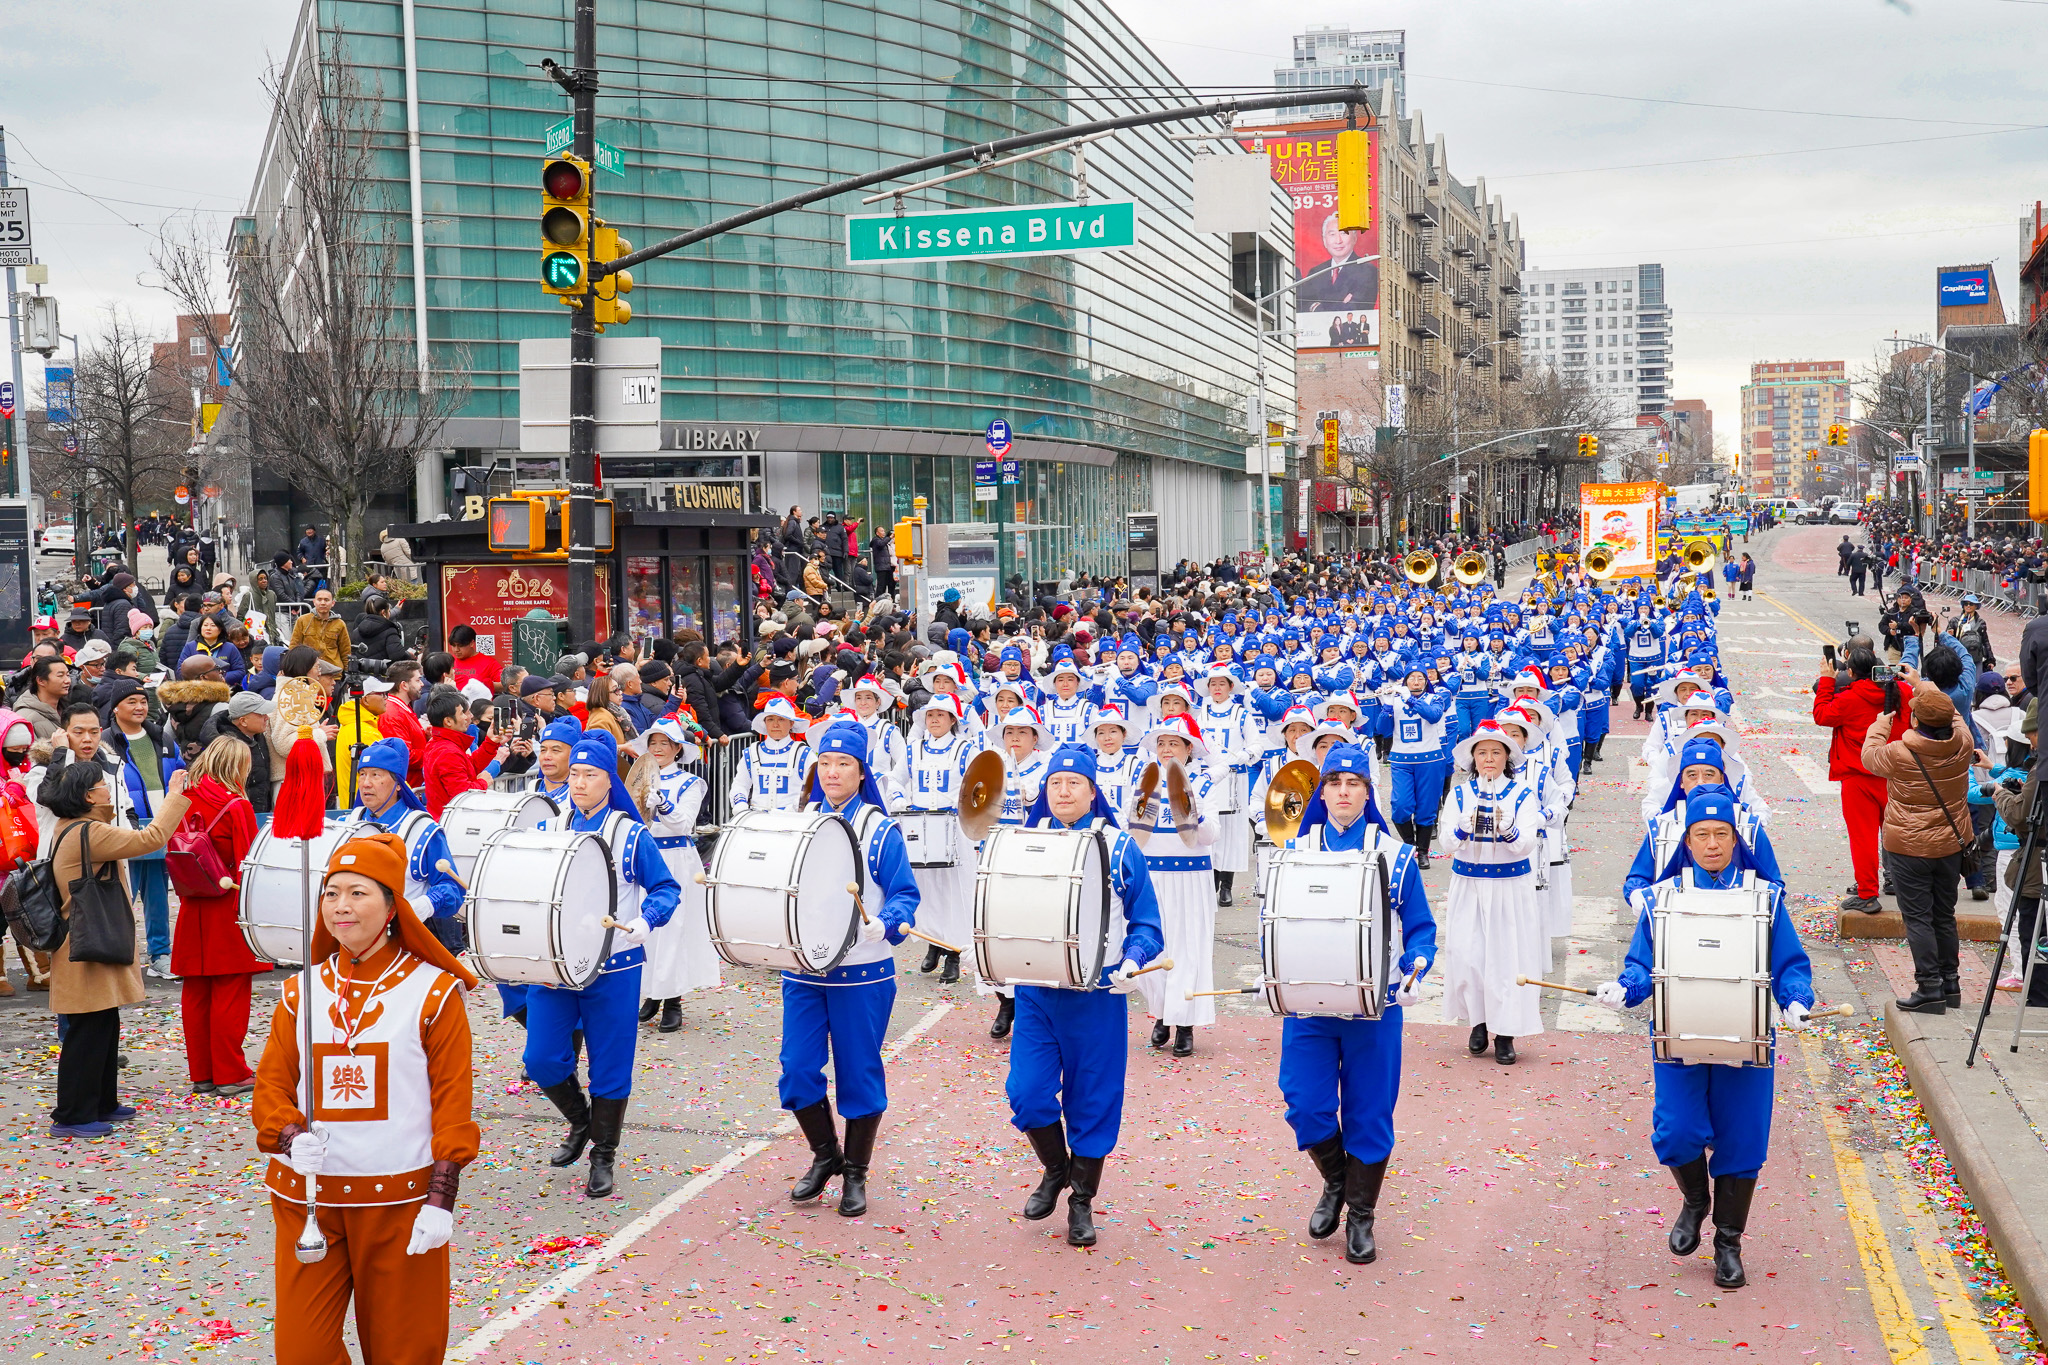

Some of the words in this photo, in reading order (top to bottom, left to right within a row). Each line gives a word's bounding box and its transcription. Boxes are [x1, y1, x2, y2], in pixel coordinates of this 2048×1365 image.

[546, 126, 570, 152] Kissena
[594, 141, 612, 168] Main
[1271, 157, 1338, 182] 外伤害
[0, 191, 12, 199] TY
[1294, 194, 1338, 210] 39-3
[878, 225, 1016, 250] Kissena
[1028, 214, 1105, 243] Blvd
[673, 428, 761, 450] LIBRARY
[1003, 462, 1016, 472] Q20
[1003, 475, 1015, 484] Q44
[673, 484, 742, 509] FLUSHING
[1591, 487, 1647, 497] 法輪大法好
[496, 577, 553, 598] 2026
[470, 615, 496, 625] 2026
[1405, 726, 1417, 737] 樂
[1003, 798, 1016, 815] 樂
[330, 1064, 368, 1102] 樂
